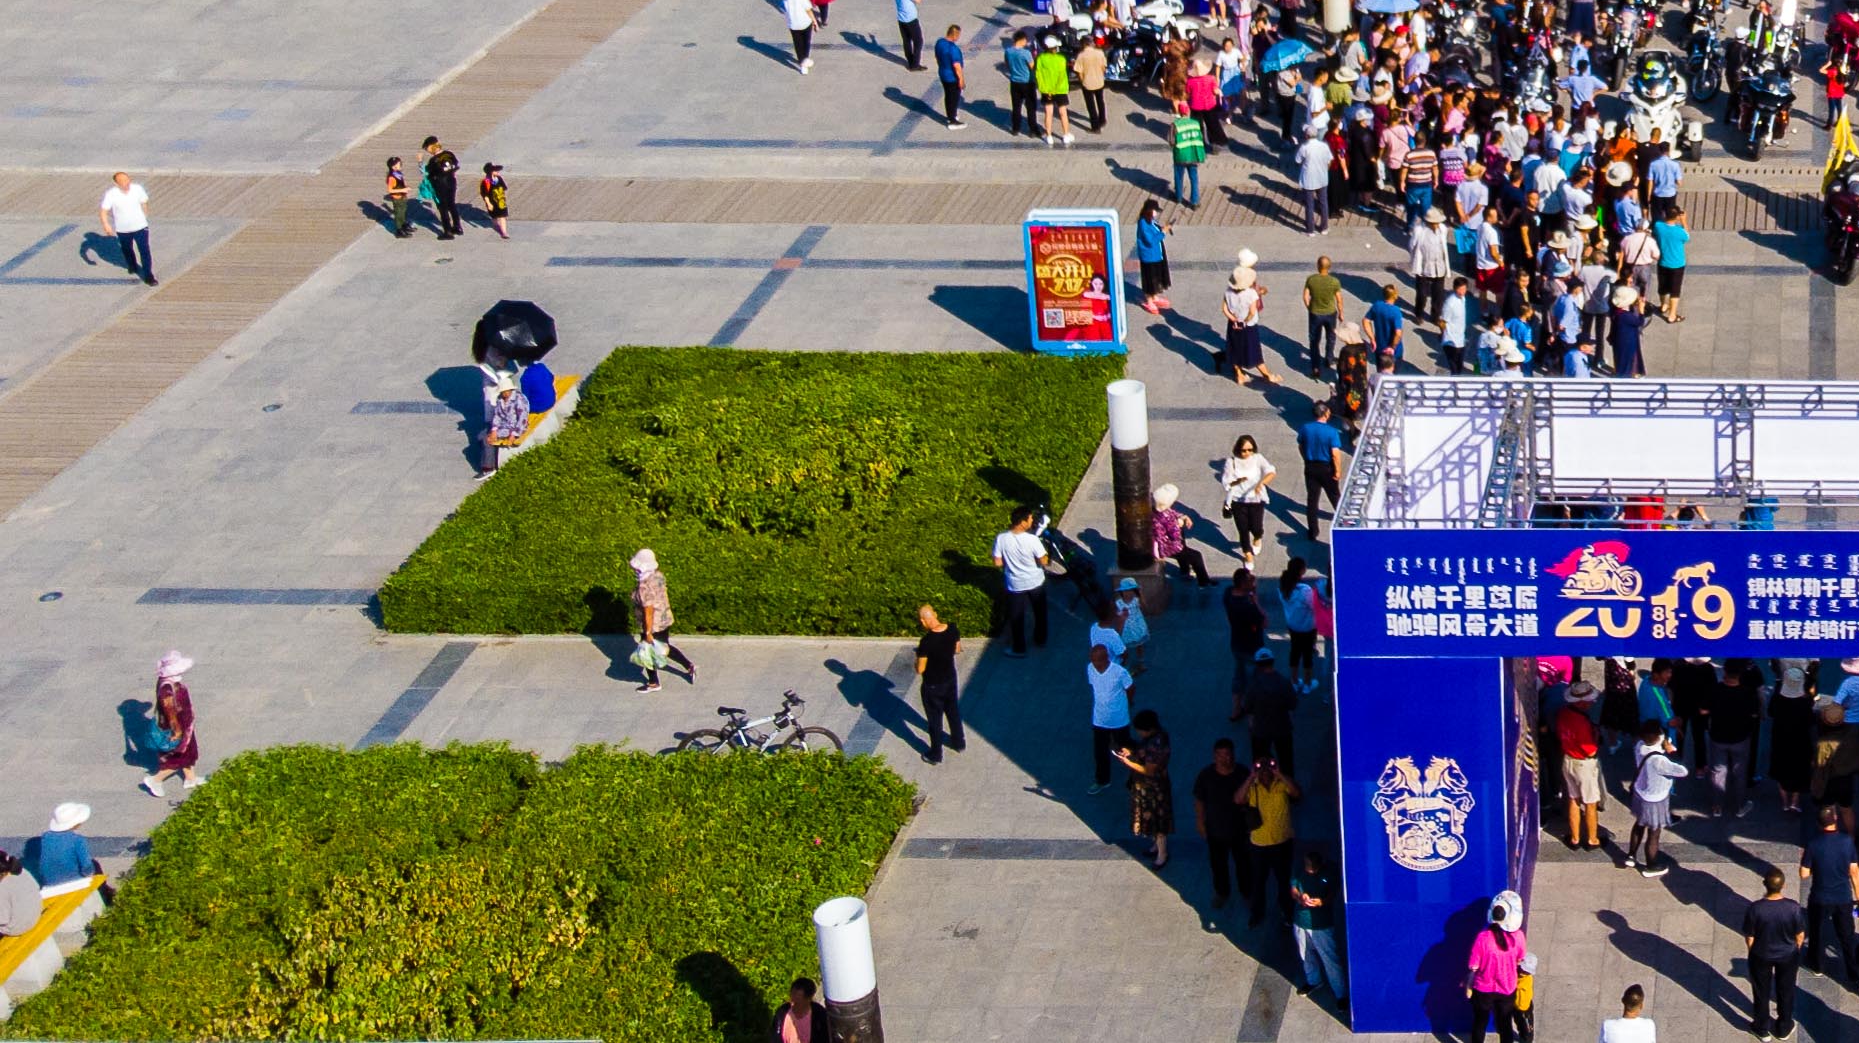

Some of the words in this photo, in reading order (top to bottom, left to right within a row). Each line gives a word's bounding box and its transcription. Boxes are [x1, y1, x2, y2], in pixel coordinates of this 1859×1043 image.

[1385, 585, 1538, 610] 纵情千里草原
[1385, 613, 1539, 637] 驰骋风景大道
